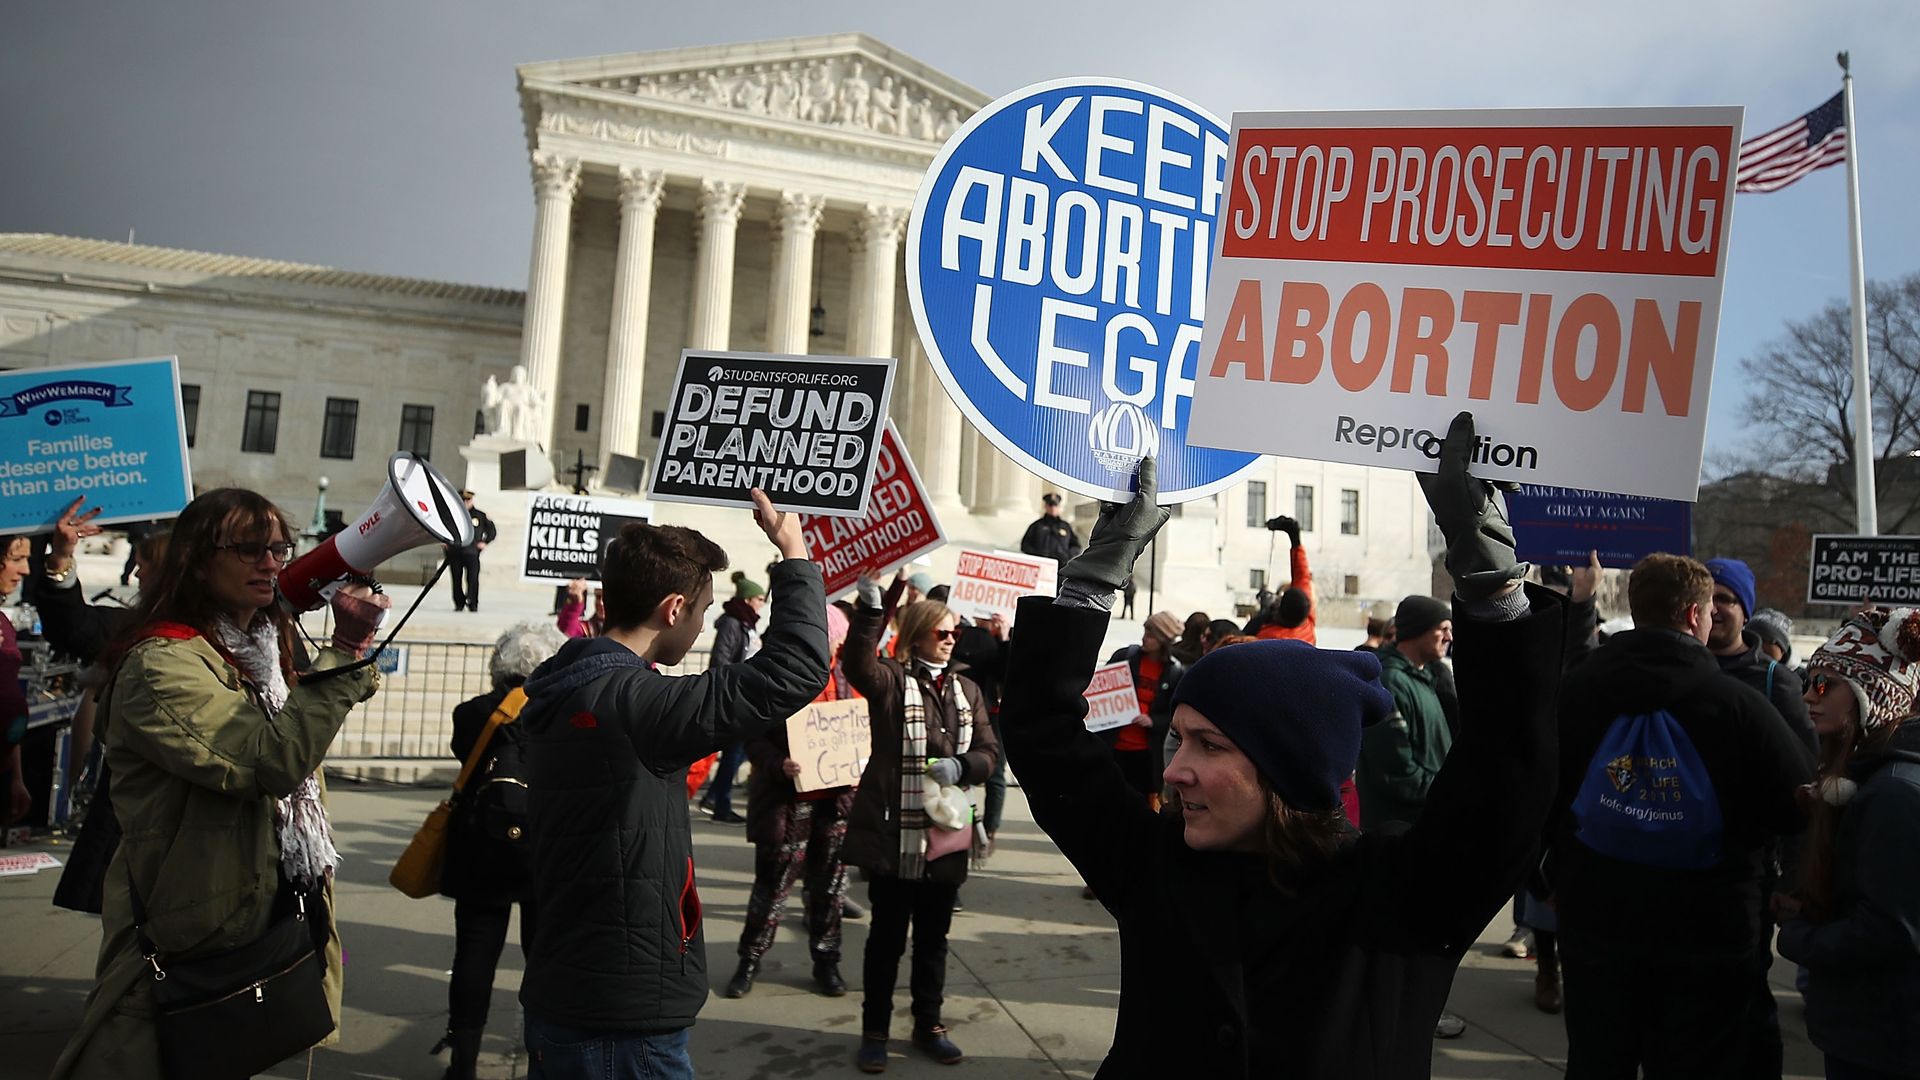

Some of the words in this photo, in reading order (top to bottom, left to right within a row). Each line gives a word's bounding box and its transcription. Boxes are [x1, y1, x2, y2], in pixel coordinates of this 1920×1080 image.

[1234, 145, 1354, 241] STOP
[1360, 145, 1720, 255] PROSECUTING
[942, 165, 1210, 320] ABORTI
[971, 283, 1203, 430] LEGA
[1209, 279, 1703, 417] ABORTION
[723, 369, 859, 386] STUDENTSFORLIFE.ORG
[677, 383, 874, 431] DEFUND
[1089, 403, 1160, 459] NOW
[1335, 416, 1538, 469] Reproation
[28, 435, 113, 456] Families
[668, 424, 865, 468] PLANNED
[1093, 451, 1139, 463] NATION
[0, 457, 79, 478] deserve
[84, 451, 148, 470] better
[1, 480, 48, 497] than
[54, 470, 148, 491] abortion.
[661, 460, 859, 497] PARENTHOOD
[359, 511, 381, 535] PYLE
[533, 511, 600, 529] ABORTION
[1546, 504, 1595, 518] GREAT
[1599, 505, 1646, 520] AGAIN!
[530, 526, 599, 551] KILLS
[529, 549, 539, 560] A
[541, 550, 597, 564] PERSON!!
[1822, 550, 1828, 562] I
[1837, 551, 1869, 563] AM
[1878, 552, 1920, 565] THE
[1815, 564, 1920, 583] PRO-LIFE
[953, 579, 1020, 609] ABORTIO
[1816, 583, 1920, 600] GENERATION
[805, 706, 870, 732] Abortio
[1090, 692, 1136, 719] RTION
